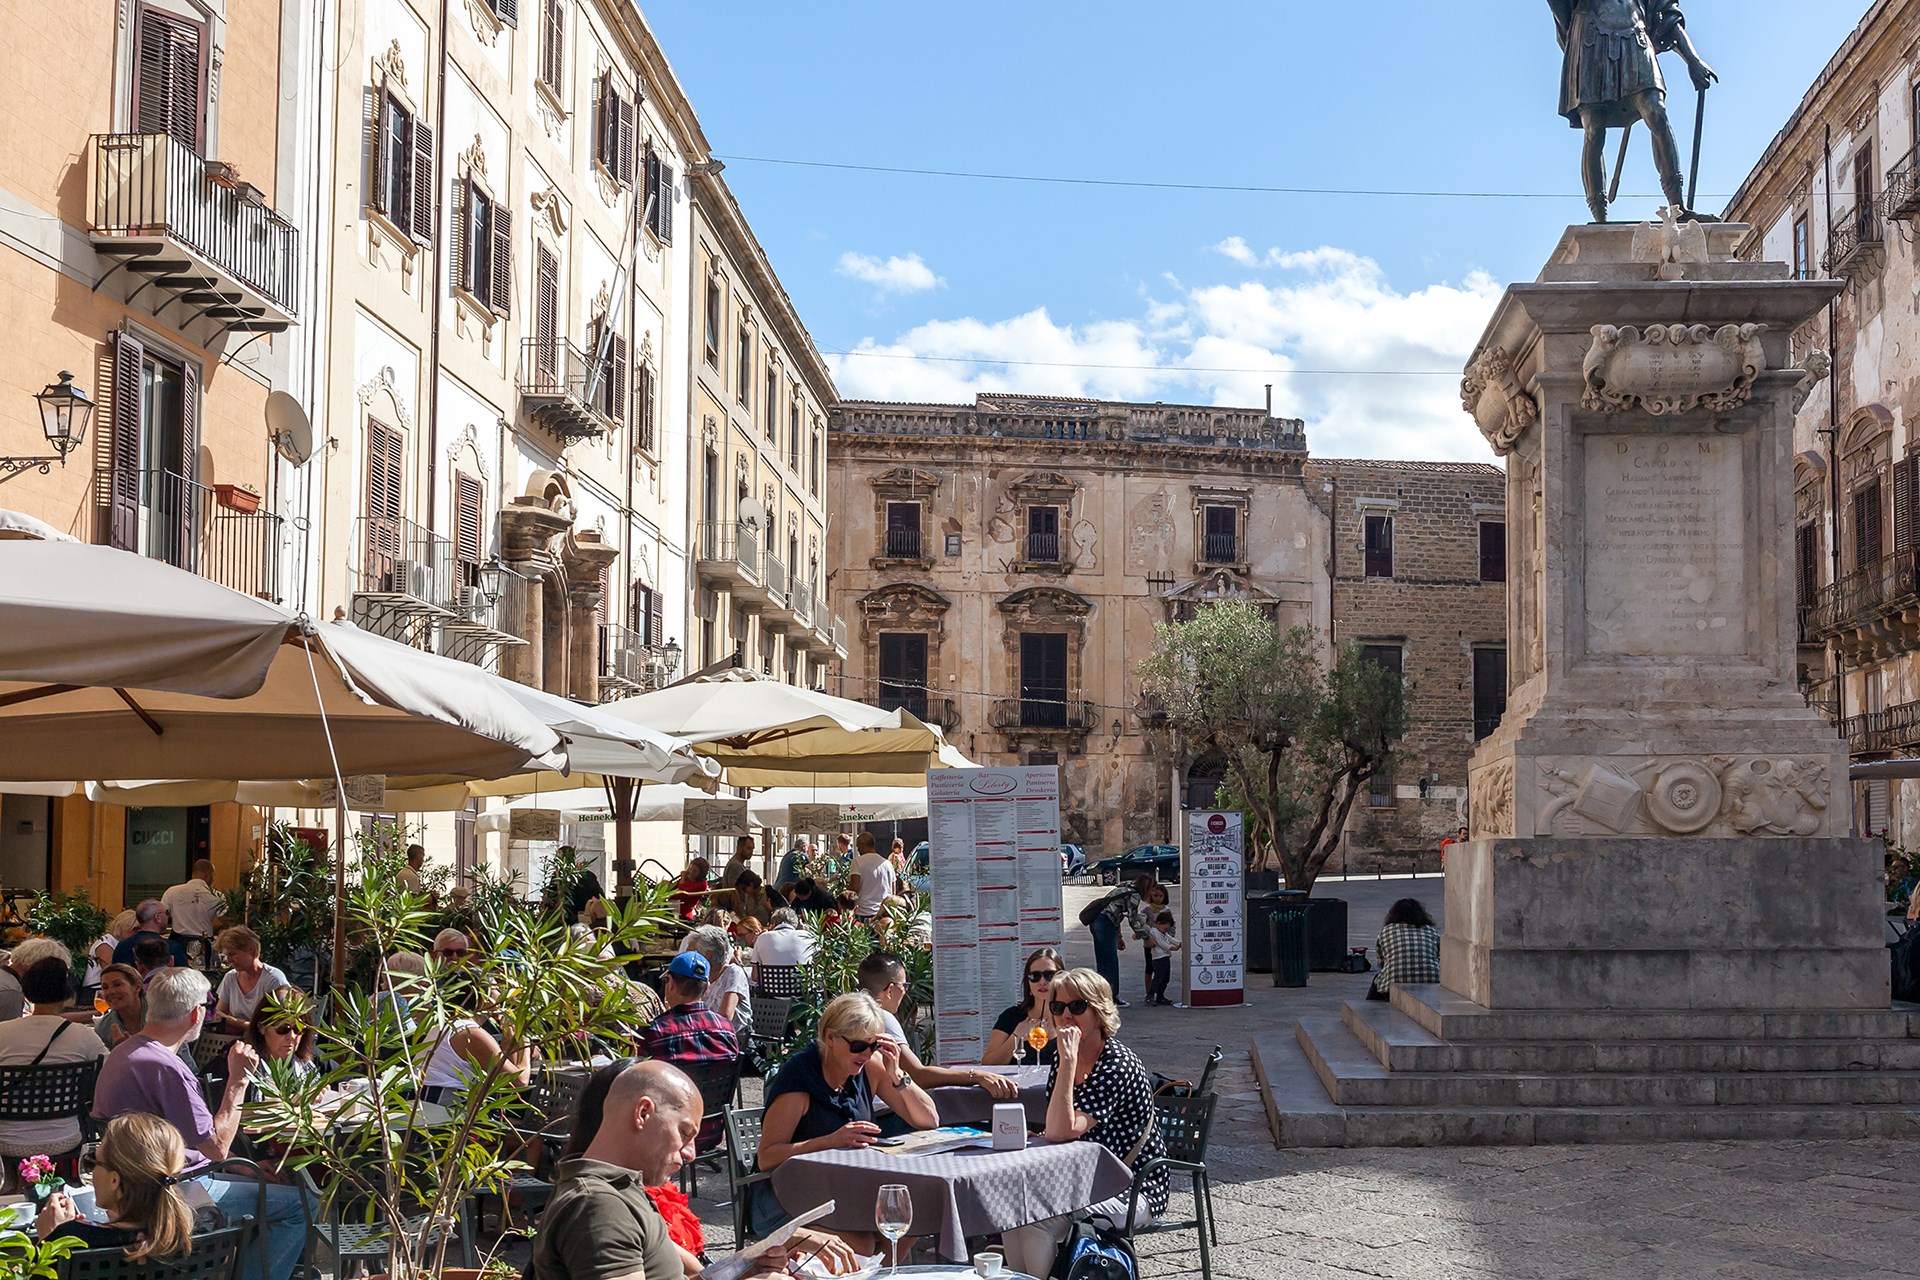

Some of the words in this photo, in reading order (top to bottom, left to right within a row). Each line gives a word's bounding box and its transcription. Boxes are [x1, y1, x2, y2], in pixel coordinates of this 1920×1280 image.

[1657, 442, 1670, 455] O
[1697, 442, 1711, 455] M
[1024, 771, 1056, 779] Apericena
[977, 779, 1011, 790] Liberty
[930, 789, 960, 797] Gelateria
[578, 813, 616, 822] Heineke
[839, 812, 875, 821] eineken
